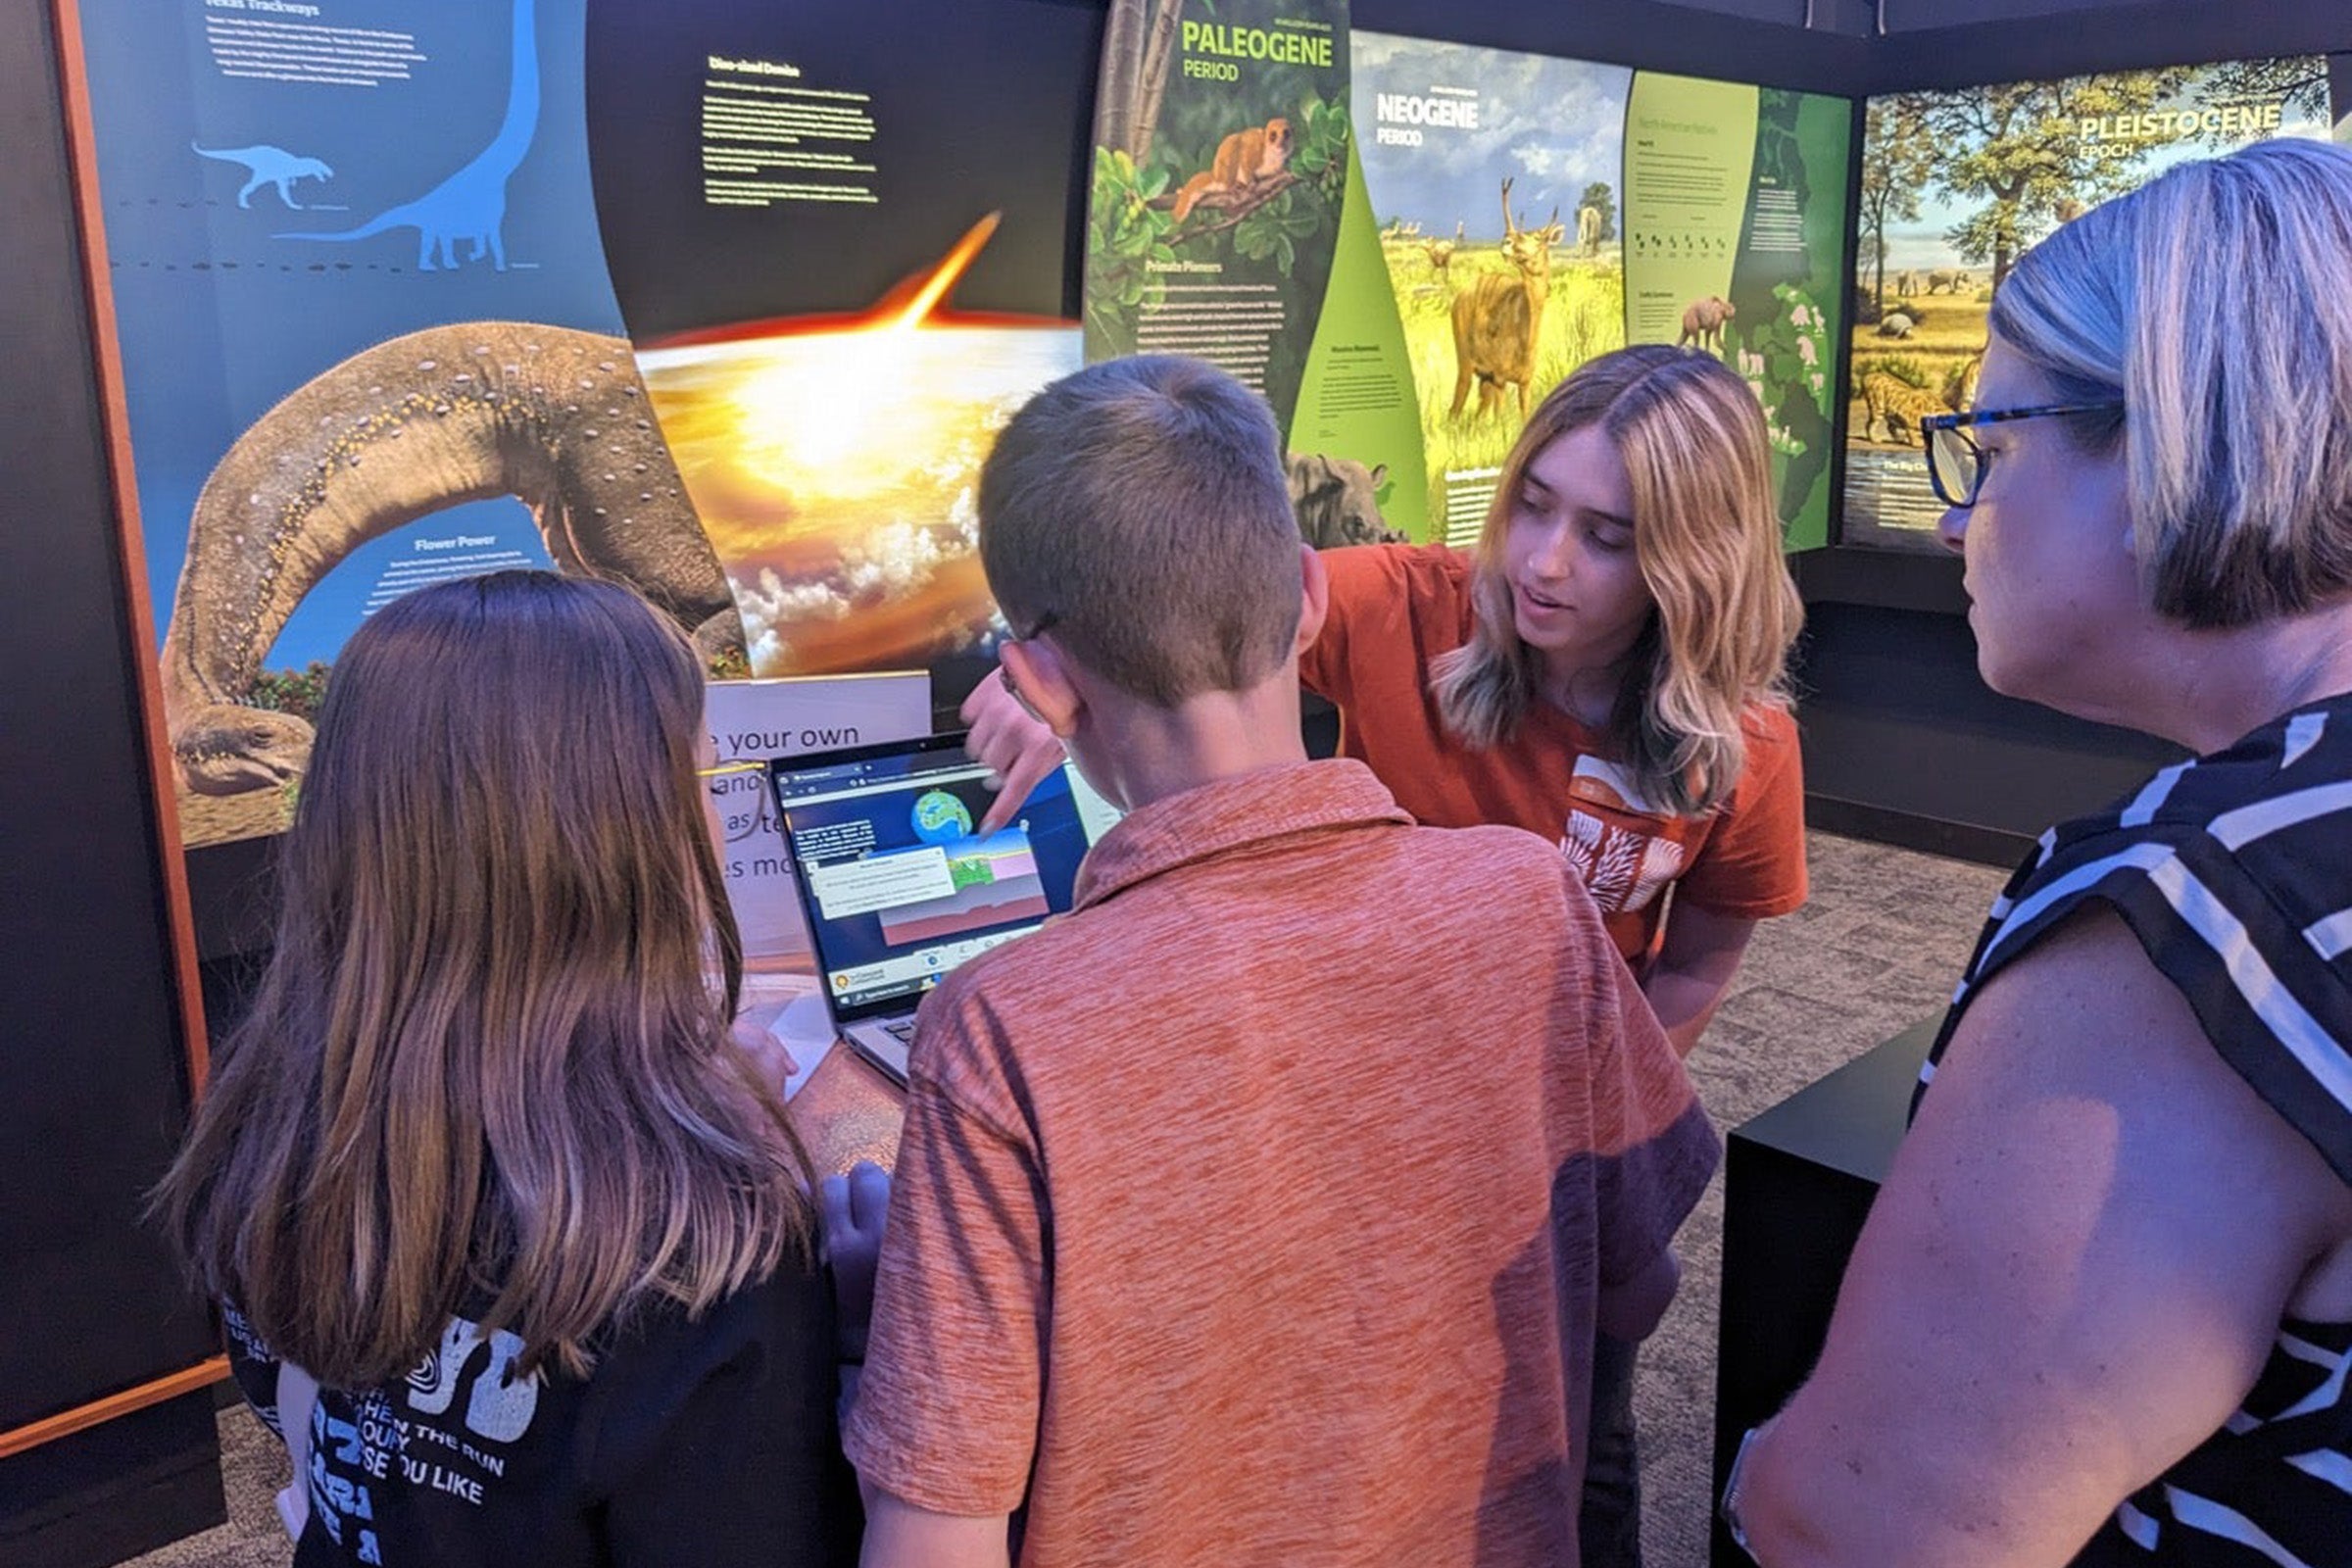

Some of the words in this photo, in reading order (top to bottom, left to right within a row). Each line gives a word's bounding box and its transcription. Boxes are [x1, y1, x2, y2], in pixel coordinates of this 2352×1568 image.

[1182, 21, 1333, 67] PALEOGENE
[1183, 59, 1239, 81] PERIOD
[1377, 93, 1479, 129] NEOGENE
[2080, 104, 2281, 140] PLEISTOCENE
[1377, 127, 1423, 146] PERIOD
[2079, 144, 2133, 160] EPOCH
[415, 539, 457, 551] Flower
[457, 536, 496, 548] Power
[728, 730, 792, 756] your
[801, 726, 858, 748] own
[415, 1425, 459, 1450] THE
[463, 1444, 505, 1478] RUN
[432, 1465, 484, 1504] LIKE
